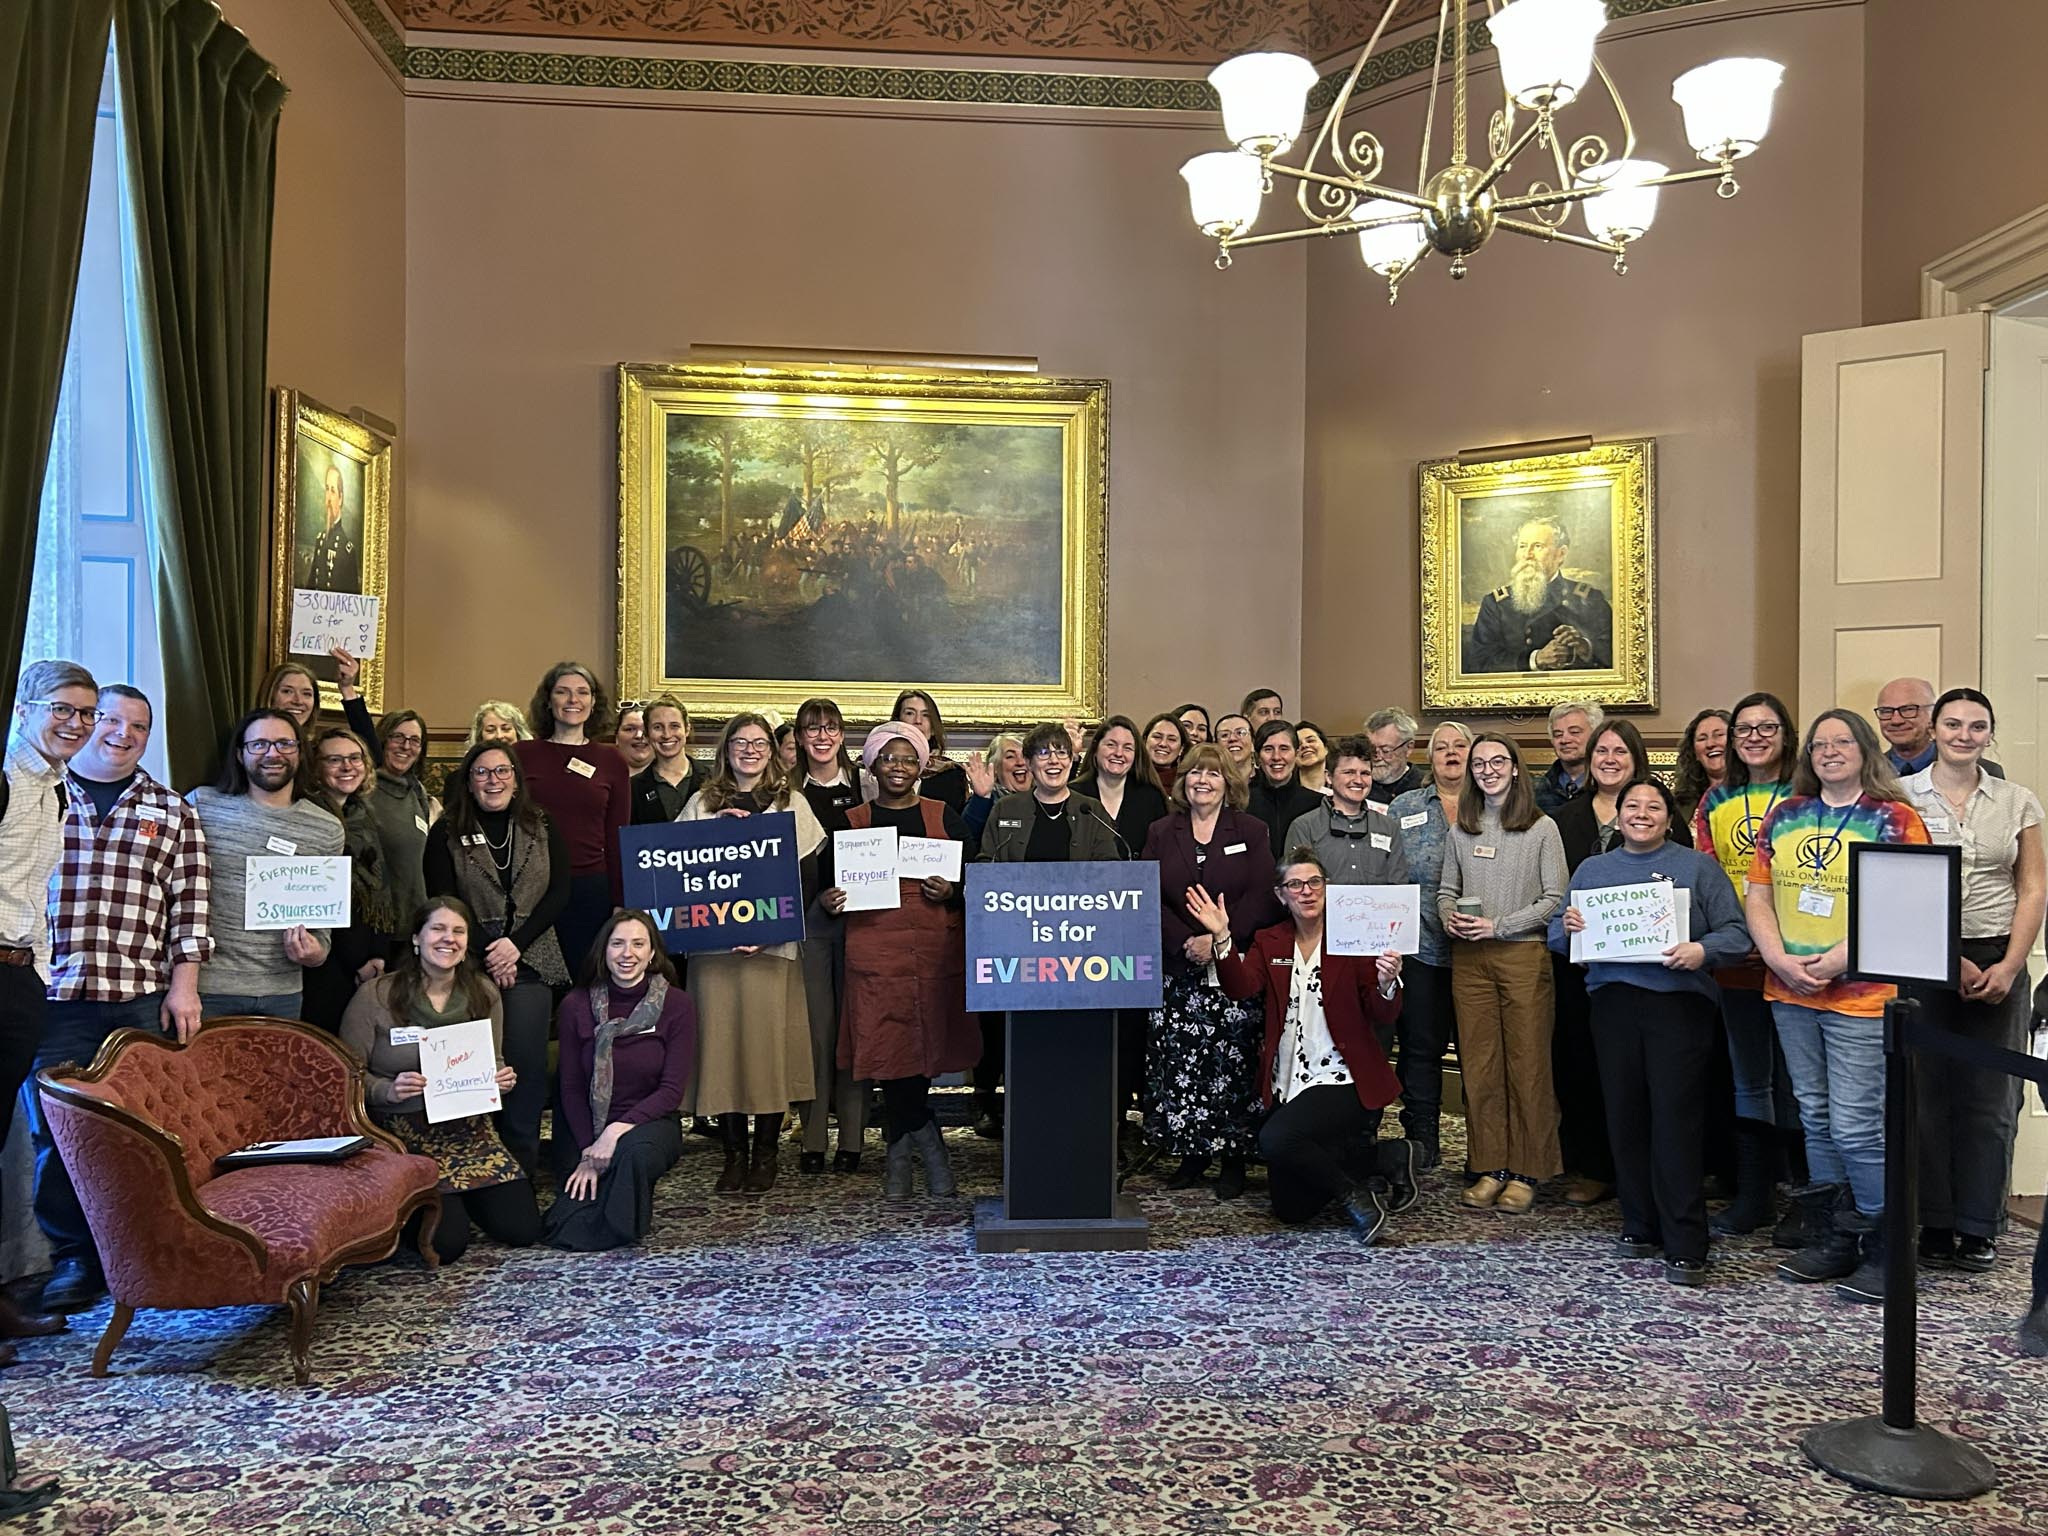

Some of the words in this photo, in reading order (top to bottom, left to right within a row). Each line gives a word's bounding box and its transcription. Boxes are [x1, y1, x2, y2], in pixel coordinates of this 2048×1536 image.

[312, 614, 322, 625] is
[326, 614, 344, 628] for
[292, 631, 352, 654] EVERYONE
[637, 837, 782, 872] 3SquaresVT
[259, 864, 320, 882] EVERYONE
[682, 872, 704, 893] is
[707, 870, 742, 891] for
[1774, 869, 1796, 879] EALS
[1818, 873, 1849, 884] WHEE
[283, 882, 327, 892] deserves
[983, 889, 1143, 918] 3SquaresVT
[1586, 888, 1660, 908] EVERYONE
[642, 895, 795, 932] VERYONE
[1601, 906, 1645, 921] NEEDS
[1031, 920, 1054, 943] is
[1059, 919, 1097, 942] for
[1605, 922, 1639, 936] FOOD
[1594, 941, 1606, 952] TO
[975, 955, 1153, 984] EVERYONE
[444, 1049, 474, 1073] loves
